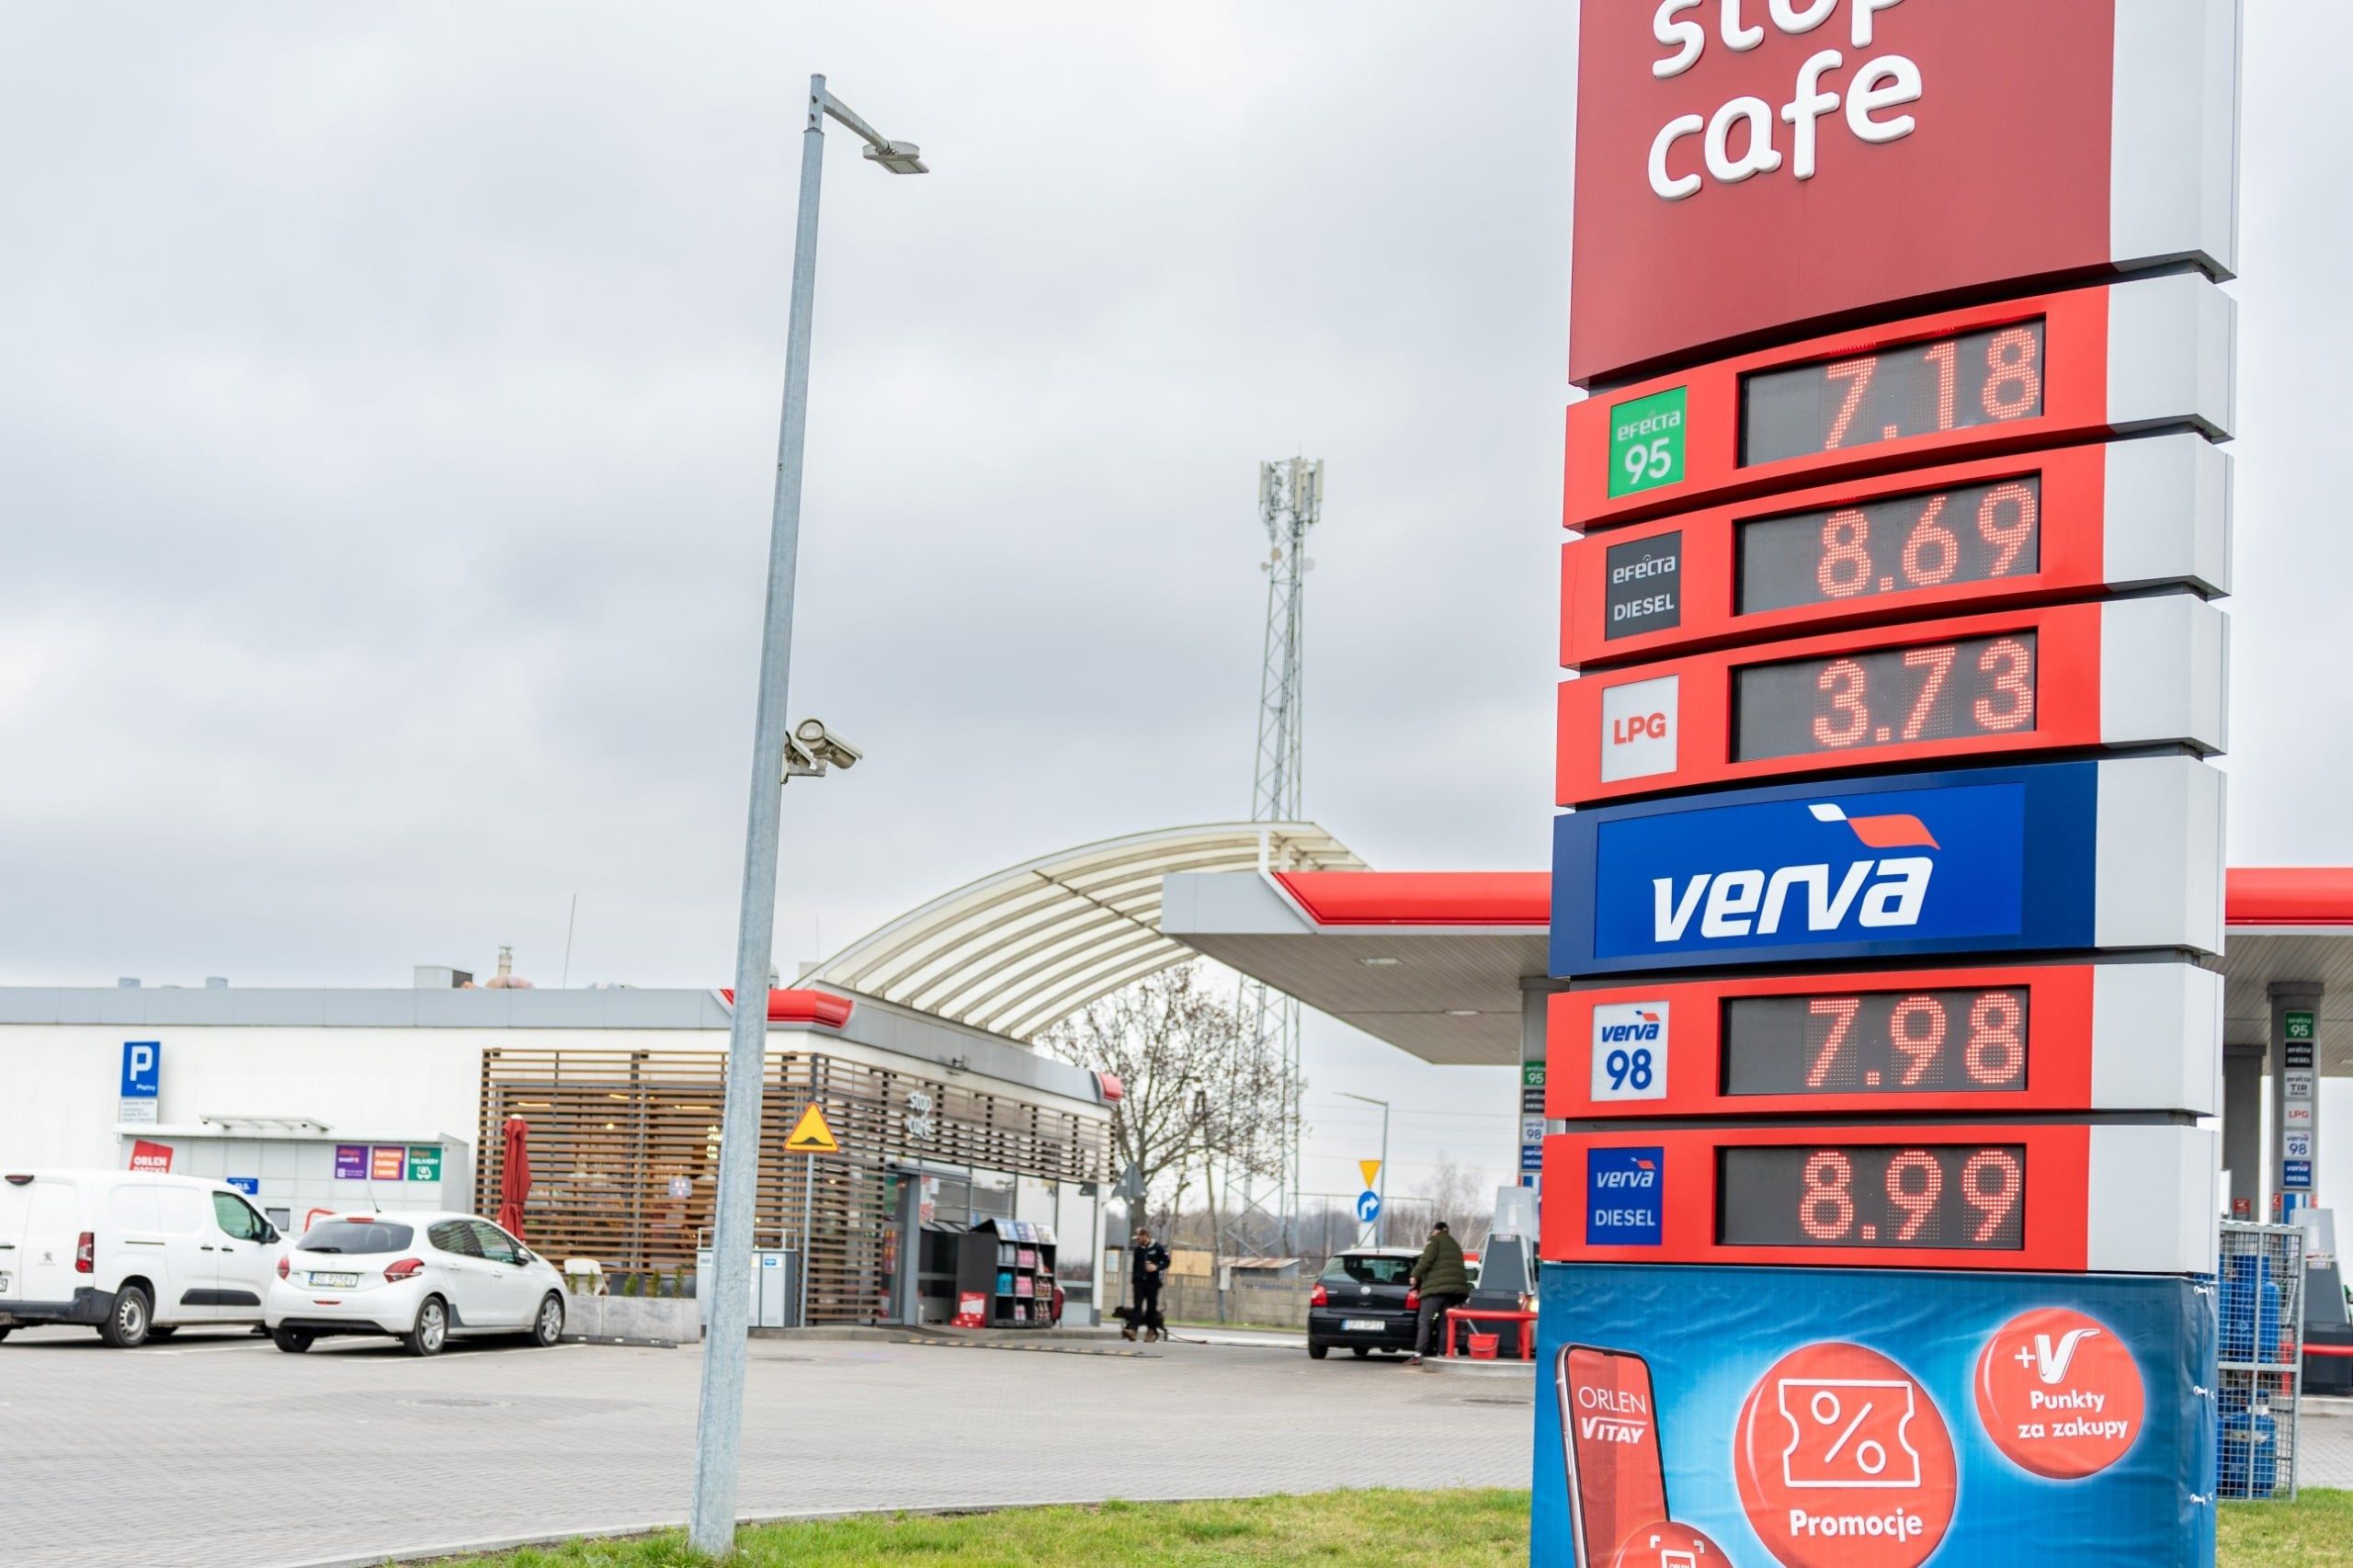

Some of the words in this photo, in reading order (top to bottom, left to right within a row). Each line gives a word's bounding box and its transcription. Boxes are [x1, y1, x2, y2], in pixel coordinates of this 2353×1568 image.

[1648, 49, 1922, 201] cafe
[1825, 328, 2040, 449] 7.18
[1624, 437, 1672, 485] 95
[1817, 483, 2036, 598] 8.69
[1614, 593, 1675, 622] DIESEL
[1814, 639, 2033, 747] 3.73
[1614, 712, 1666, 745] LPG
[1652, 856, 1934, 943] verva
[1601, 1022, 1660, 1043] verva
[1805, 993, 2024, 1086] 7.98
[2290, 1024, 2309, 1038] 95
[130, 1045, 153, 1082] P
[1528, 1072, 1544, 1085] 95
[1606, 1048, 1653, 1091] 98
[2290, 1084, 2308, 1092] TIR
[2288, 1109, 2310, 1119] LPG
[1526, 1128, 1542, 1141] 98
[2289, 1142, 2308, 1155] 98
[1597, 1170, 1655, 1188] verva
[1799, 1149, 2021, 1241] 8.99
[1595, 1209, 1656, 1227] DIESEL
[1577, 1385, 1648, 1415] ORLEN
[2029, 1389, 2106, 1414] Punkty
[1580, 1415, 1648, 1445] VITAY
[2018, 1424, 2046, 1439] za
[2052, 1415, 2129, 1440] zakupy
[1789, 1506, 1924, 1543] Promocje
